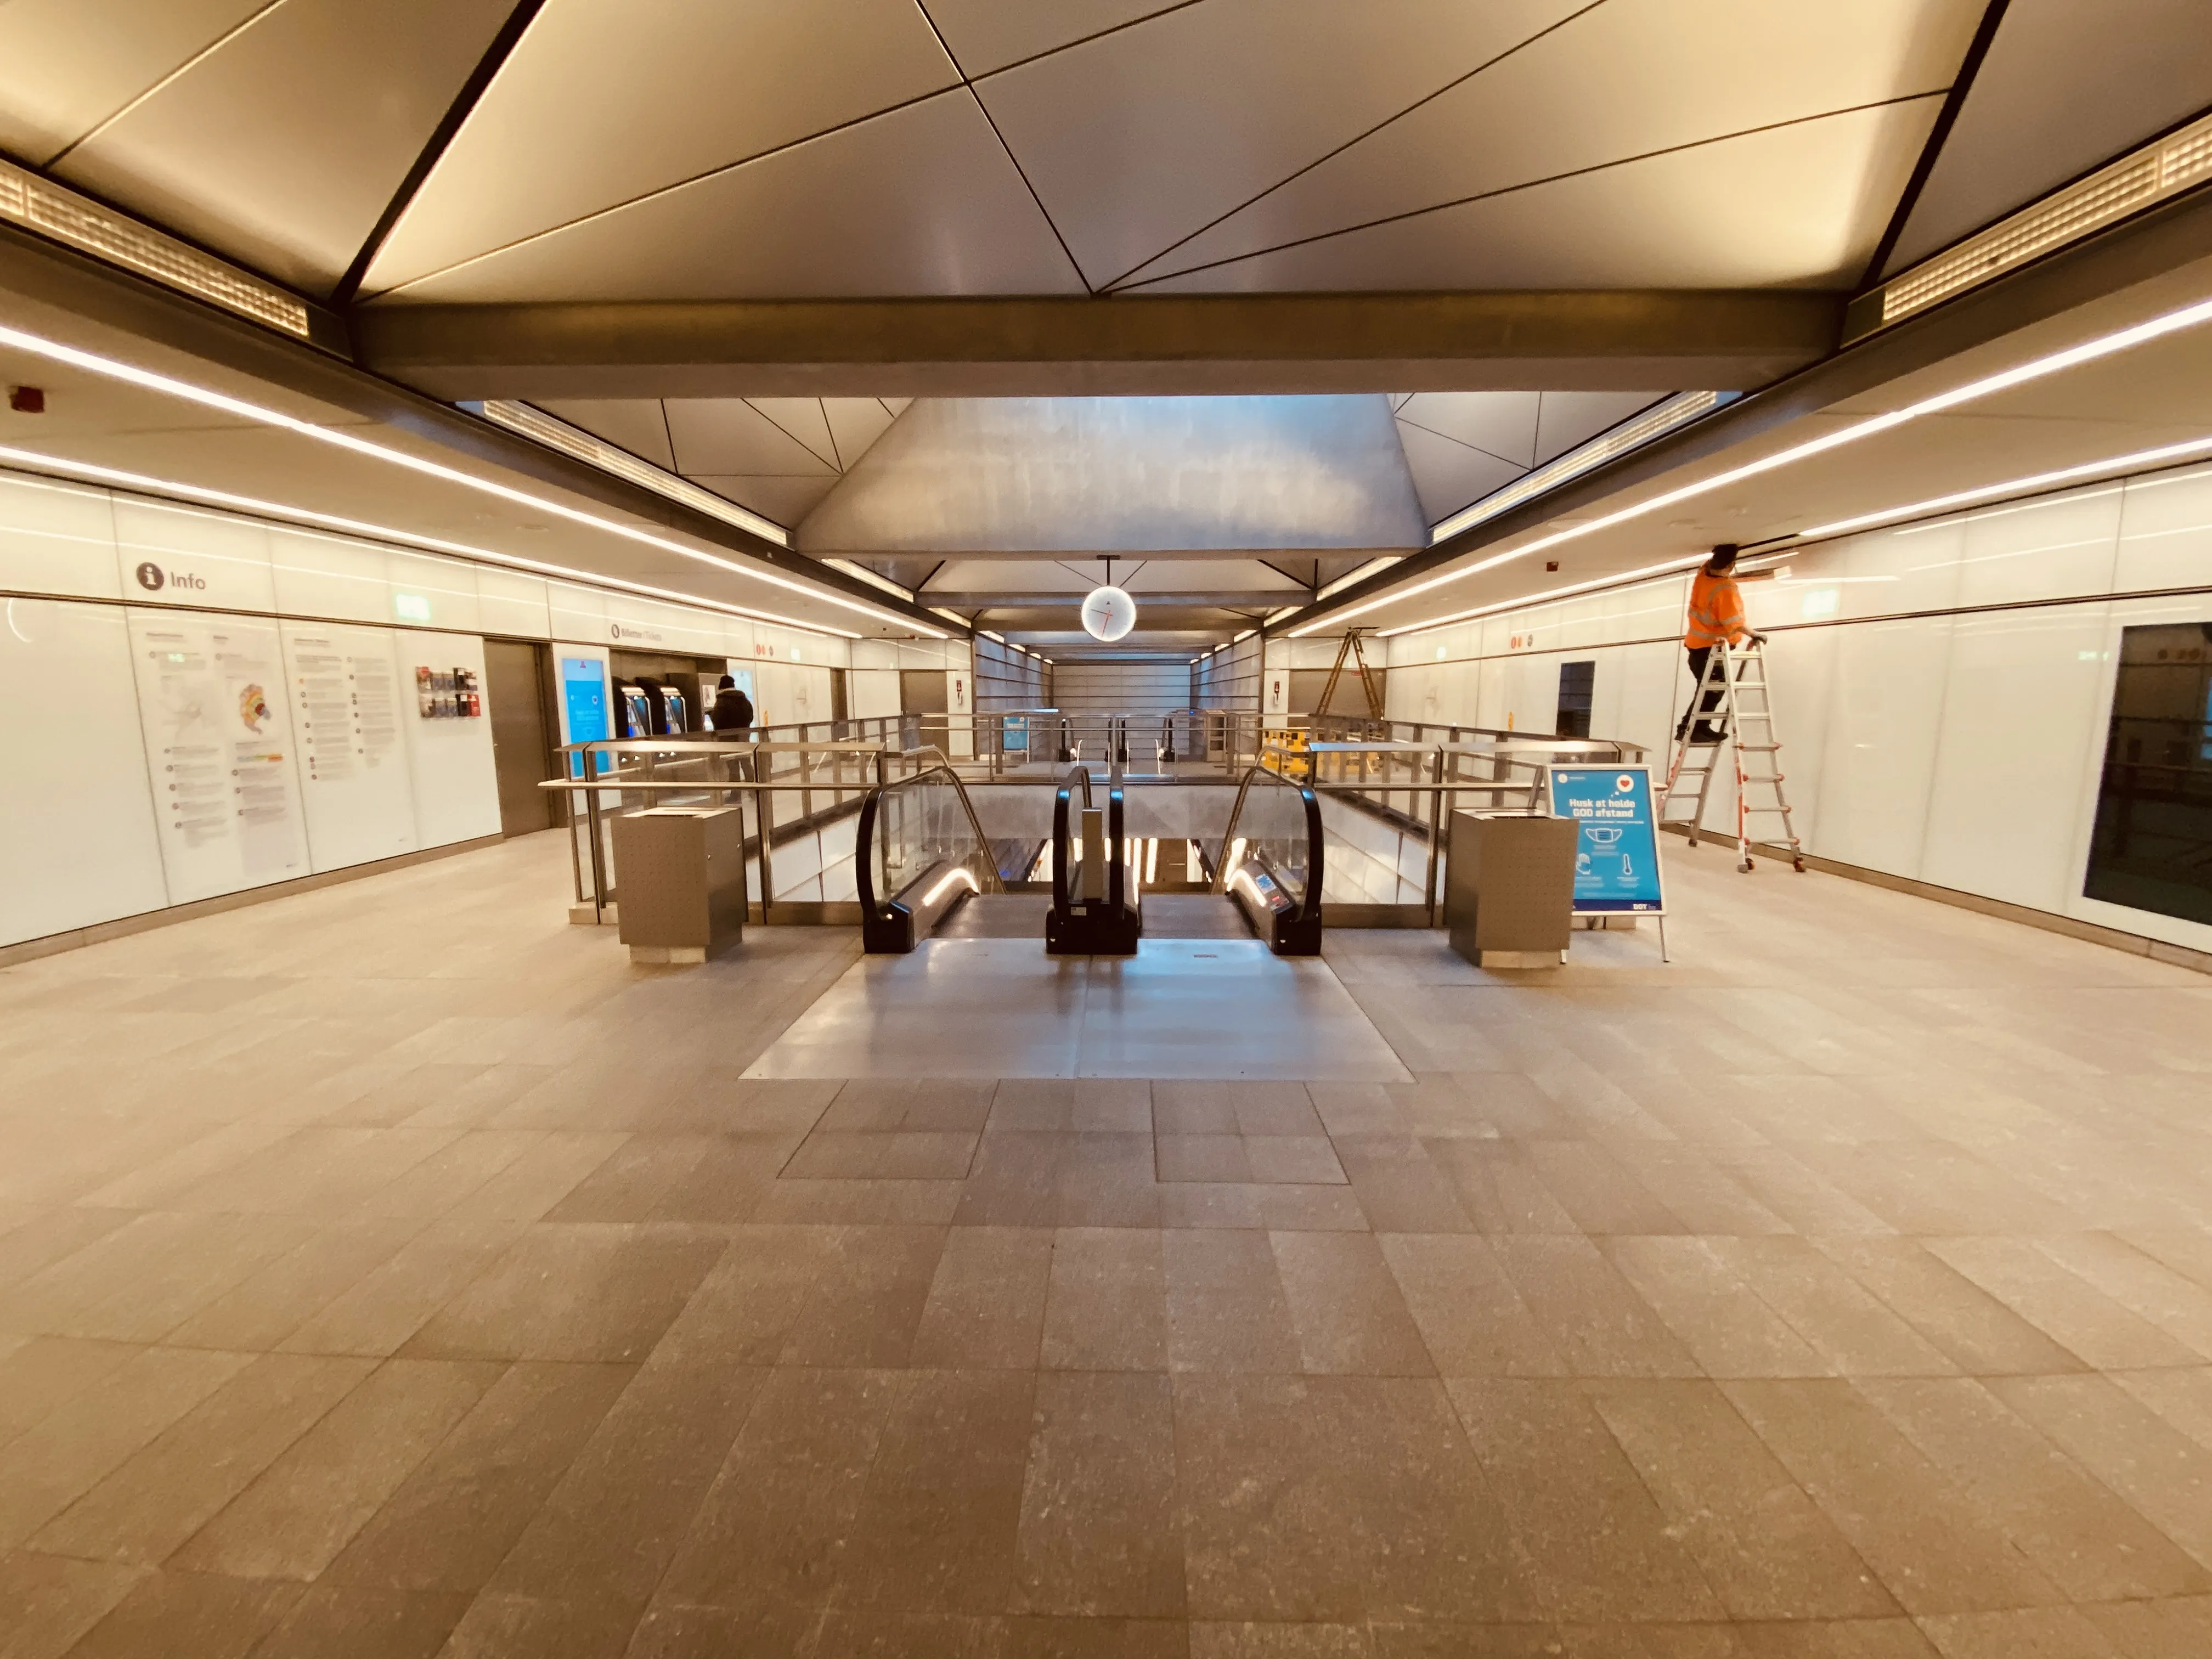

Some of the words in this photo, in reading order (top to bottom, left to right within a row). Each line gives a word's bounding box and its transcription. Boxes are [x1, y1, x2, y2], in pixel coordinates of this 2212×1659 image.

[170, 571, 206, 590] Info
[1569, 798, 1593, 808] Husk
[1595, 799, 1606, 808] at
[1573, 808, 1593, 817] GOD
[1595, 809, 1634, 817] afstand
